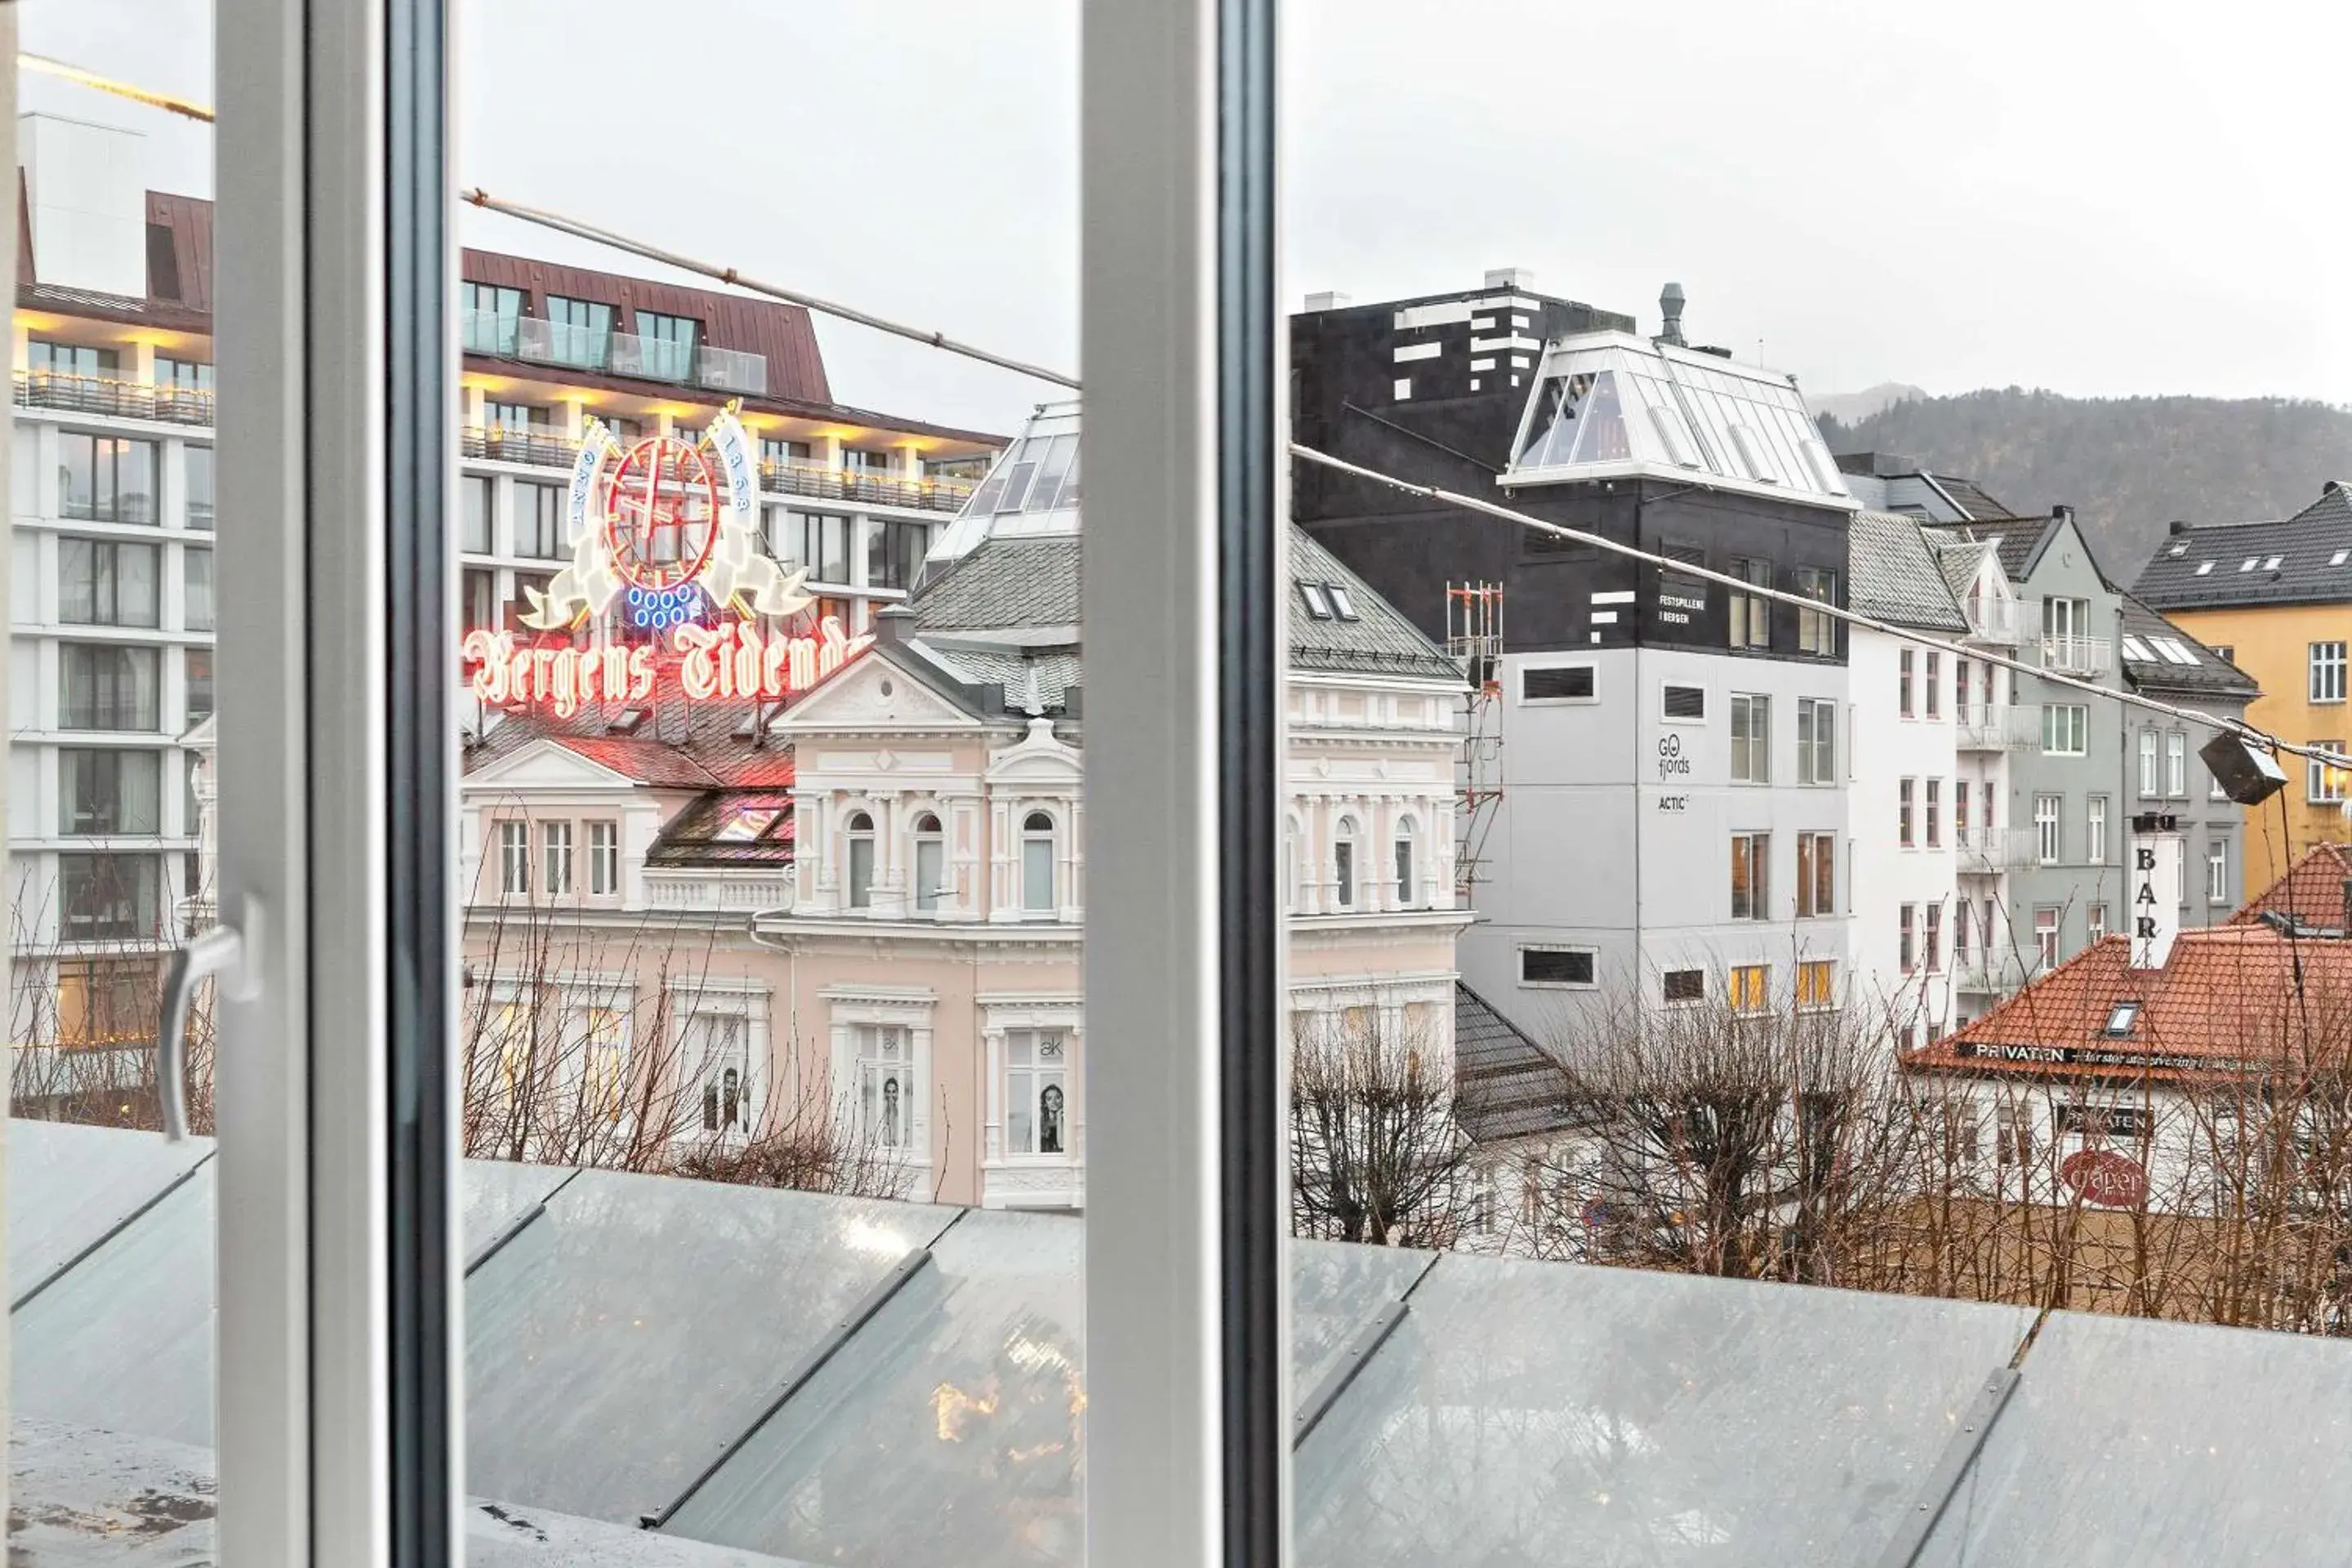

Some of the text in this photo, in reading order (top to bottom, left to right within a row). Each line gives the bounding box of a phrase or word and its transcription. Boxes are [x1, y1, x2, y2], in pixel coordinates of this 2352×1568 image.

[572, 450, 595, 527] ANNO
[463, 628, 657, 719] Bergens
[1659, 733, 1680, 757] GO
[1659, 755, 1690, 782] fjords
[2136, 848, 2158, 938] BAR
